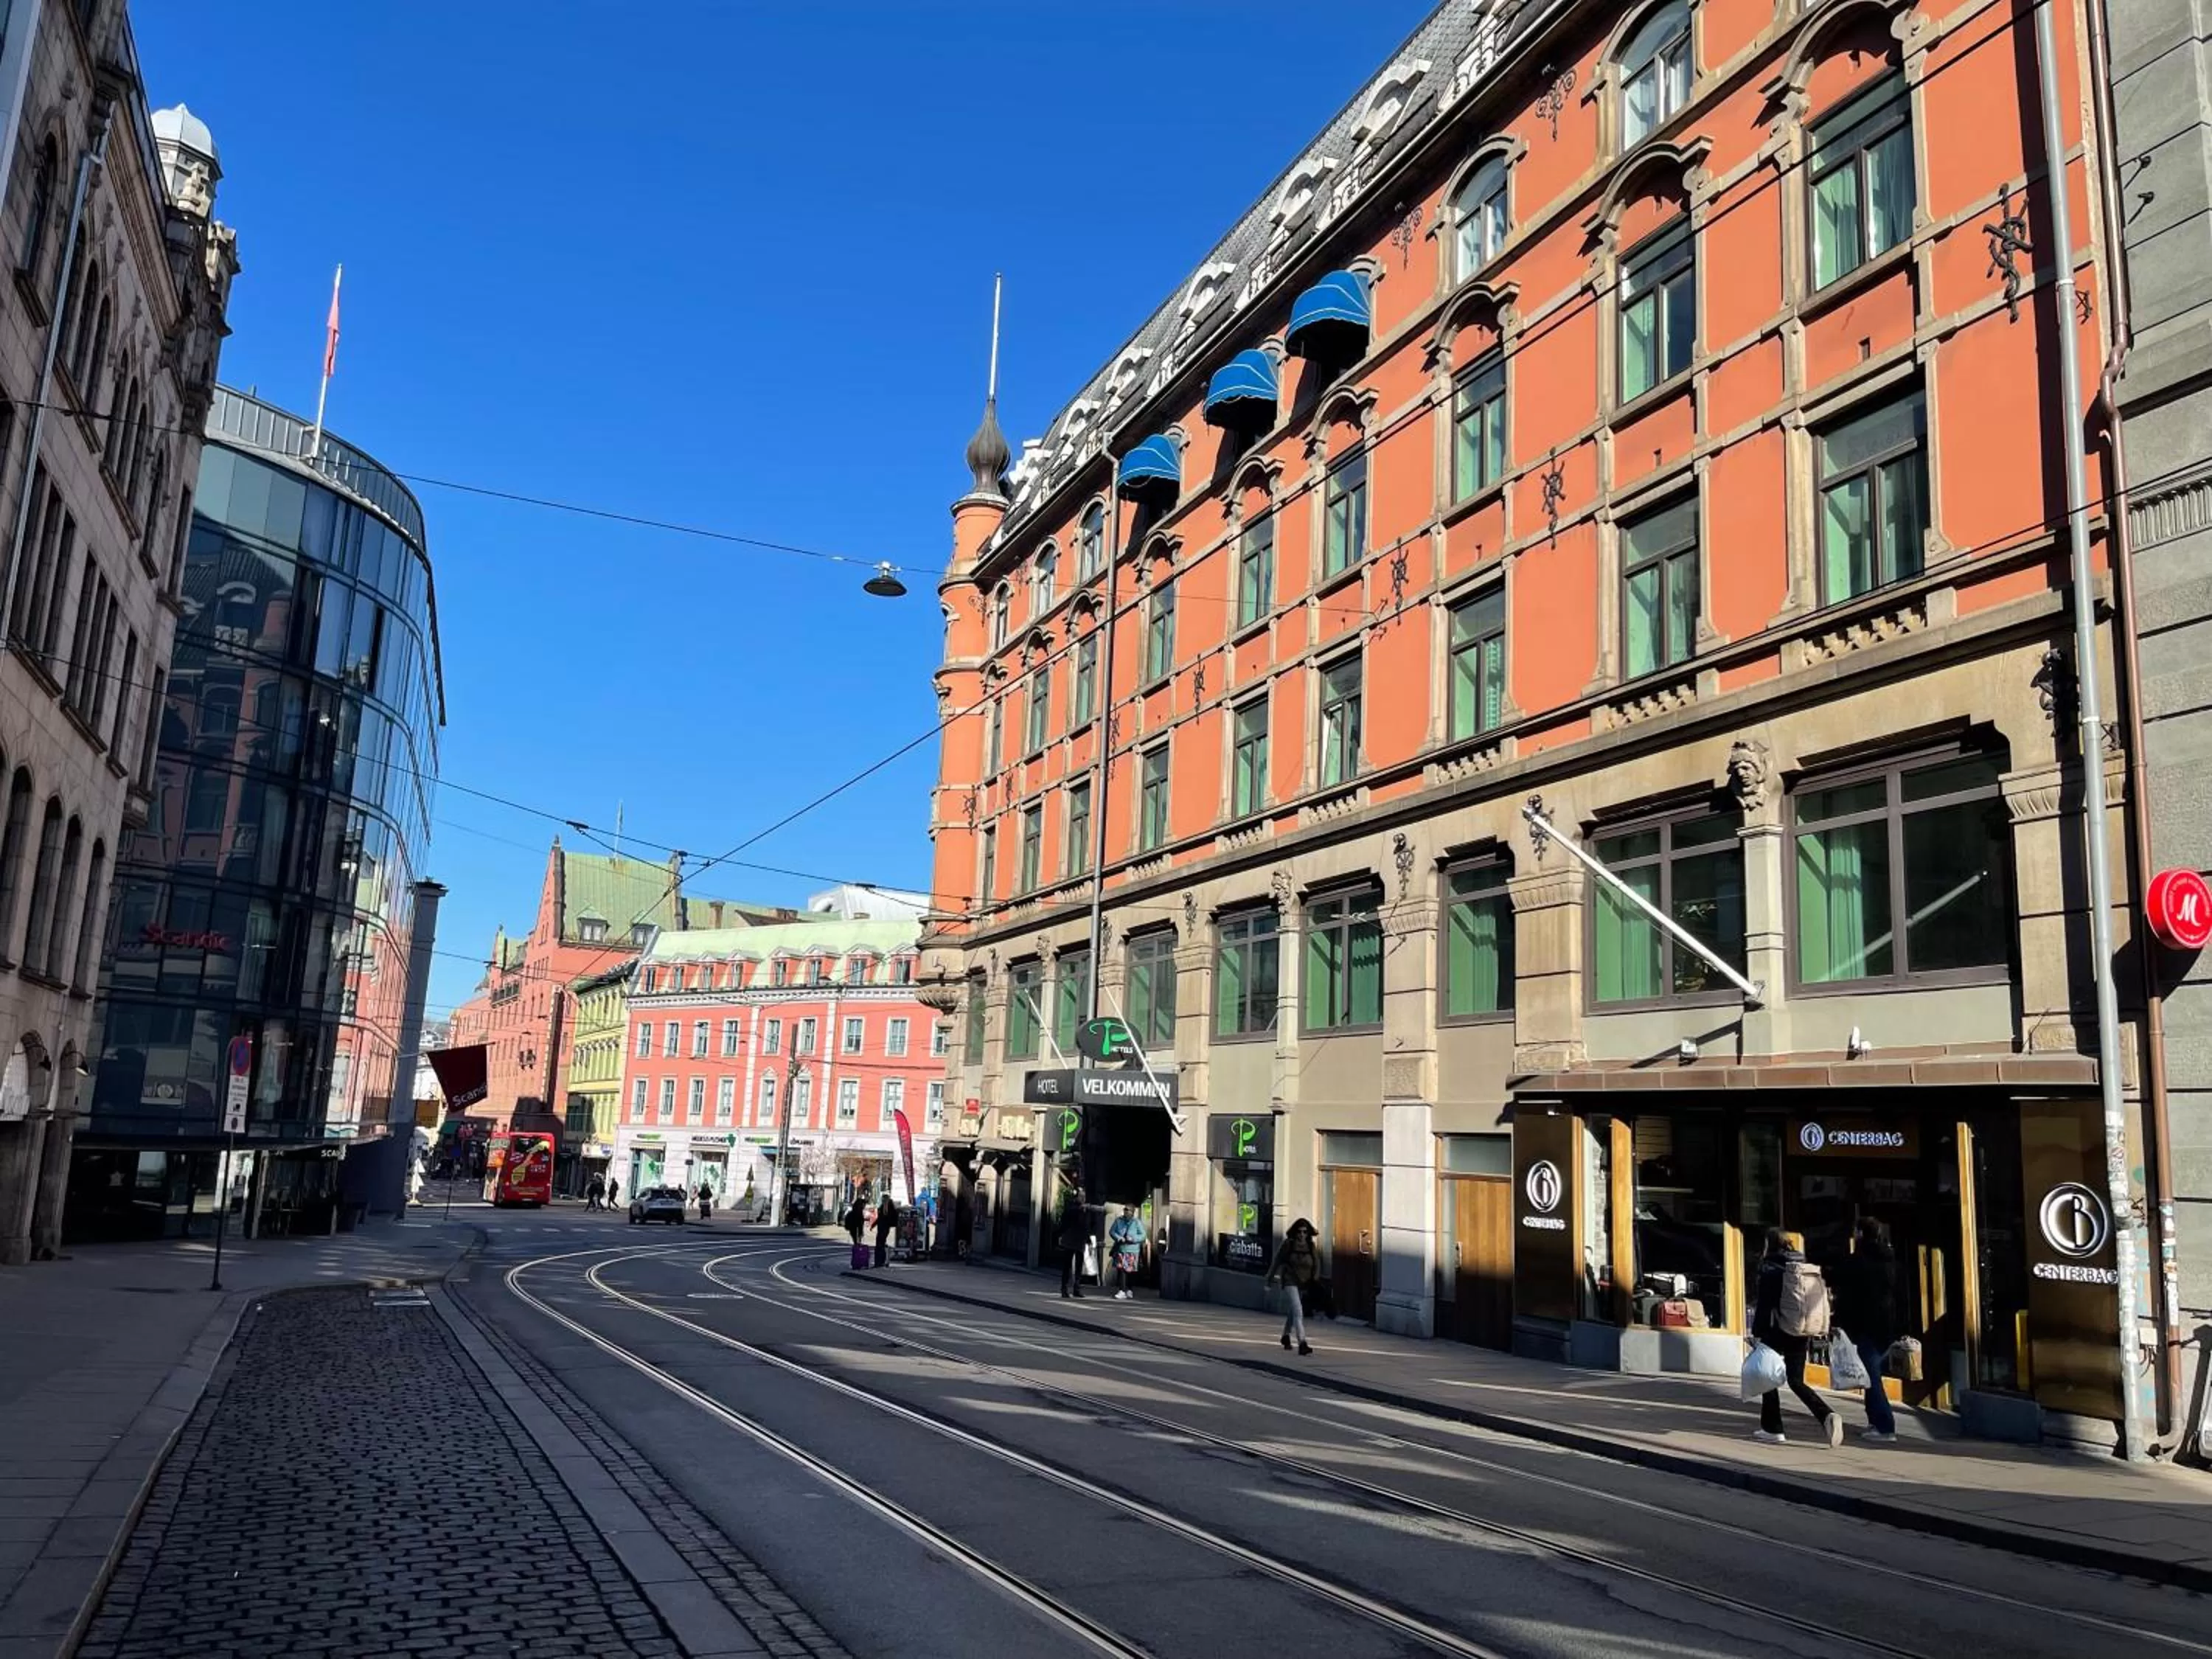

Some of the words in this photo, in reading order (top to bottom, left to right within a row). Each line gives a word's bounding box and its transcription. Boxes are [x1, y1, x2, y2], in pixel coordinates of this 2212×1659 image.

[2177, 894, 2202, 927] M
[1037, 1079, 1059, 1094] HOTEL
[1829, 1131, 1904, 1147] CENTERBAG
[2033, 1262, 2118, 1284] CENTERBAG
